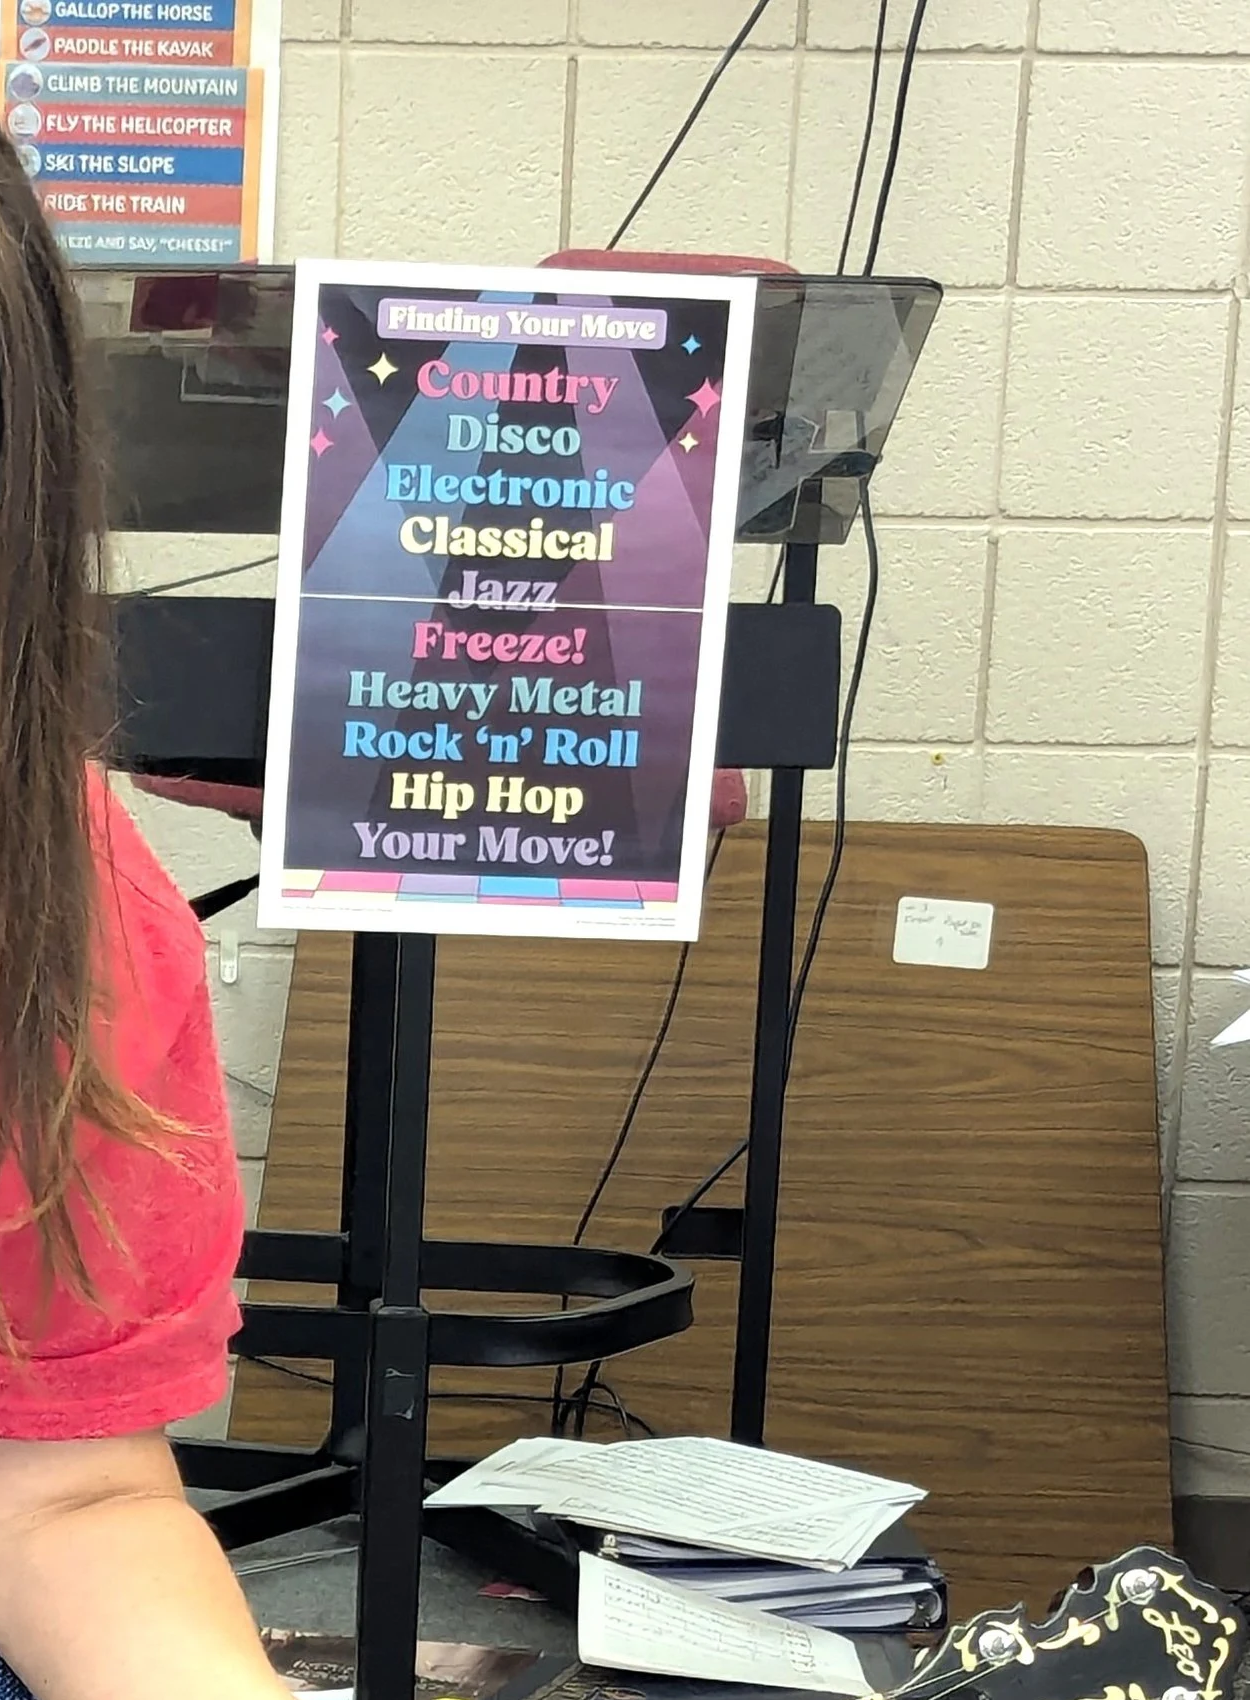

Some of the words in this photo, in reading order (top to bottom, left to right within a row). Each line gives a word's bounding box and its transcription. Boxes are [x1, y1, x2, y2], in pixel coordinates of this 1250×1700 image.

[55, 2, 120, 19] GALLOP
[122, 3, 154, 20] THE
[157, 5, 213, 22] HORSE
[54, 37, 119, 55] PADDLE
[122, 39, 154, 56] THE
[157, 41, 214, 58] KAYAK
[47, 75, 102, 92] CLIMB
[105, 76, 139, 94] THE
[144, 77, 238, 96] MOUNTAIN
[46, 114, 78, 132] FLY
[81, 115, 117, 133] THE
[120, 116, 232, 137] HELICOPTER
[44, 154, 75, 172] SKI
[78, 155, 114, 173] THE
[117, 156, 175, 175] SLOPE
[44, 193, 88, 212] RIDE
[91, 194, 126, 213] THE
[129, 195, 186, 214] TRAIN
[94, 236, 125, 250] AND
[129, 236, 156, 253] SAY,
[387, 305, 499, 339] Finding
[506, 310, 575, 337] Your
[580, 314, 656, 340] Move
[416, 360, 620, 414] Country
[446, 411, 581, 456] Disco
[385, 463, 635, 510] Electronic
[399, 516, 614, 561] Classical
[448, 570, 558, 612] Jazz
[411, 620, 587, 665] Freeze!
[347, 670, 499, 721] Heavy
[509, 676, 642, 717] Metal
[342, 721, 464, 761] Rock
[543, 728, 639, 768] Roll
[389, 771, 475, 820] Hip
[485, 776, 584, 824] Hop
[351, 822, 467, 861] Your
[476, 825, 615, 866] Move!
[1142, 1607, 1204, 1684] Leo
